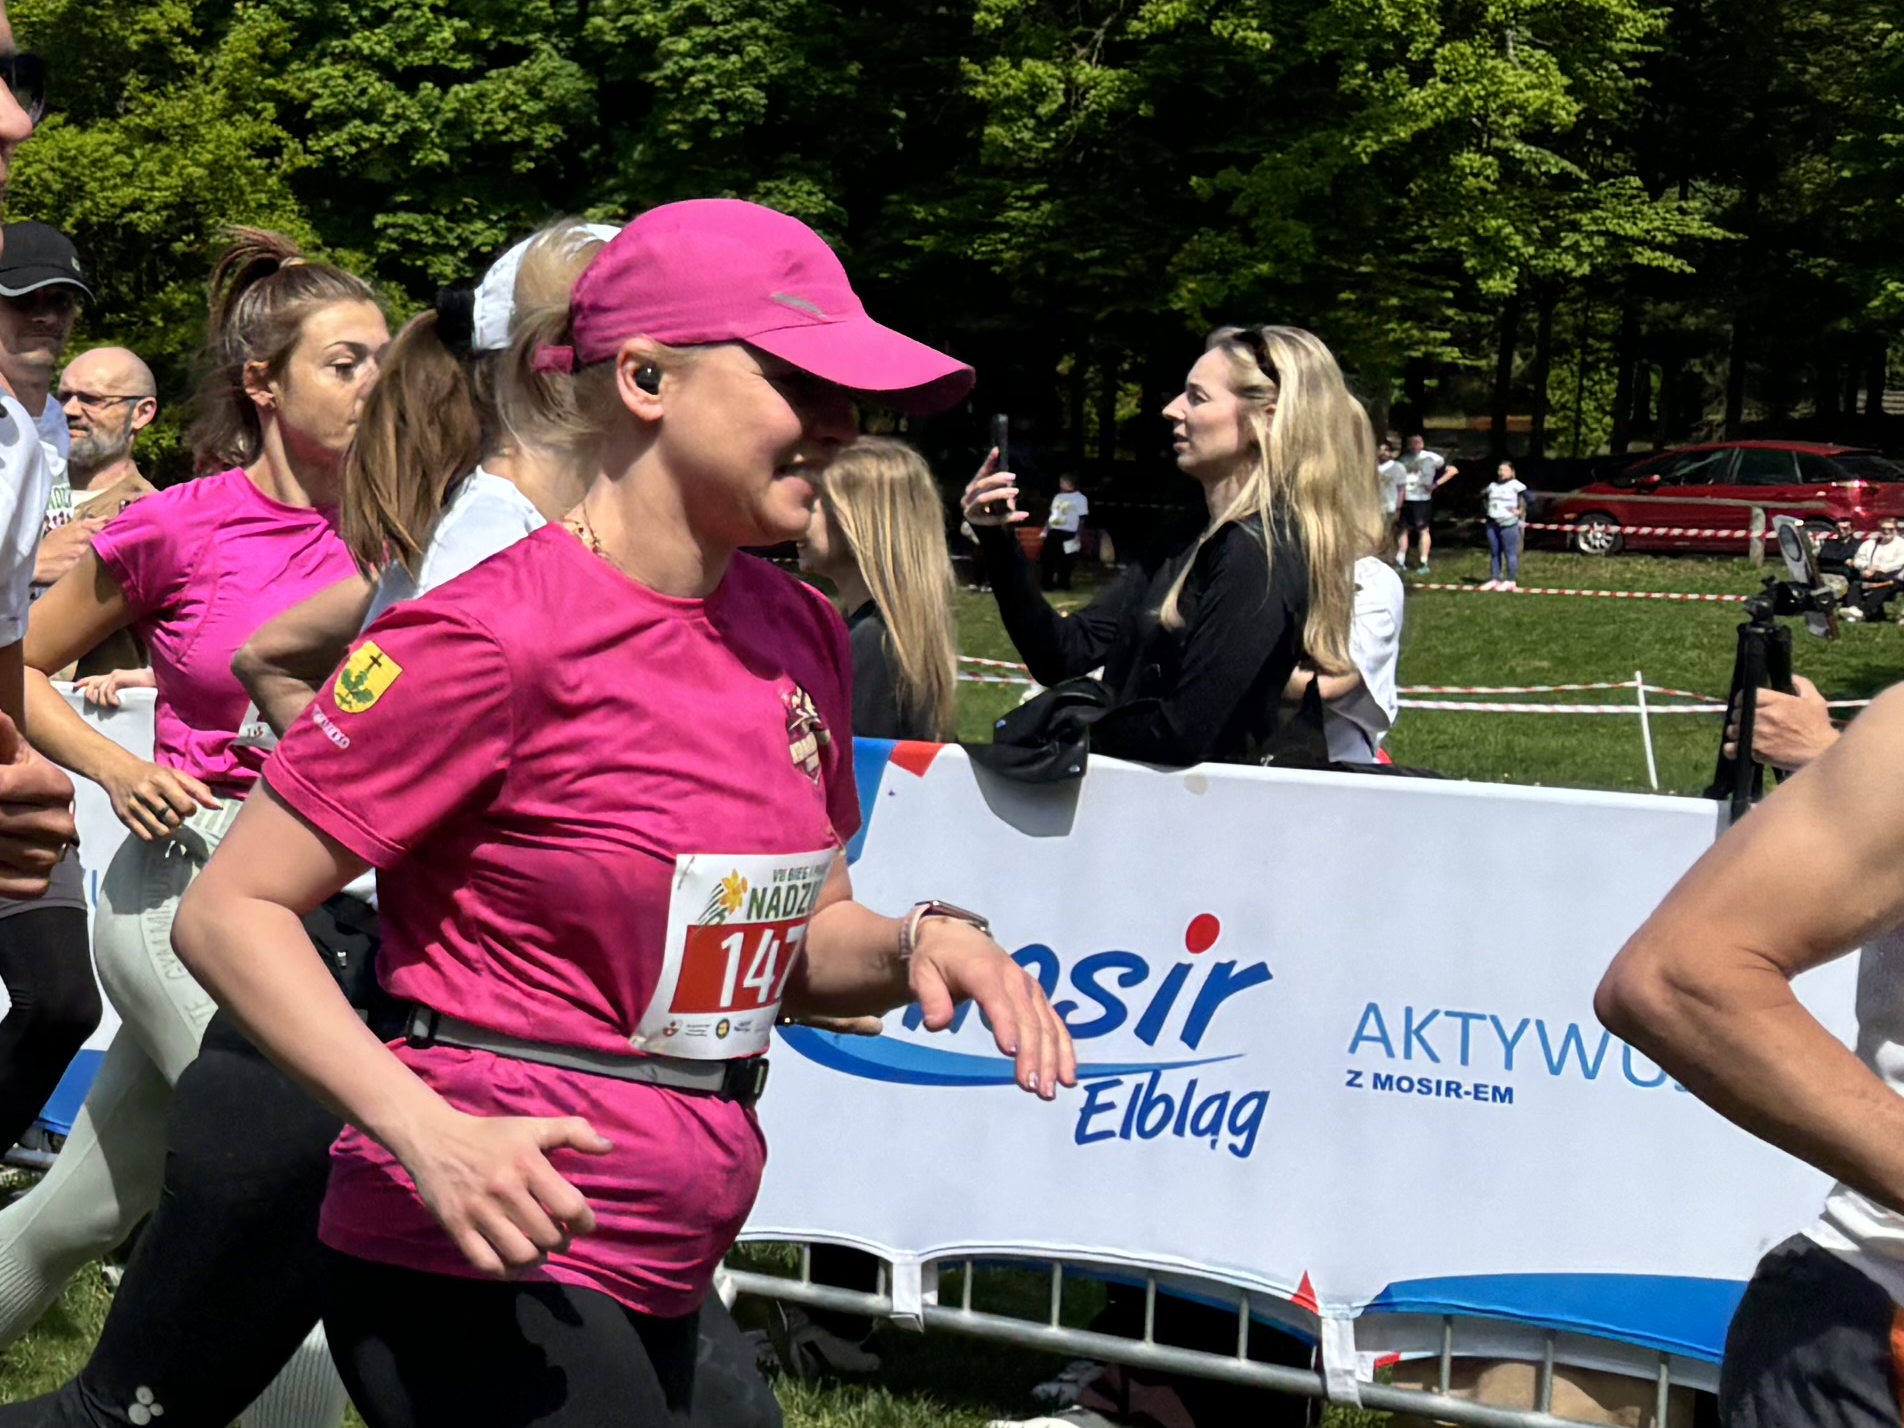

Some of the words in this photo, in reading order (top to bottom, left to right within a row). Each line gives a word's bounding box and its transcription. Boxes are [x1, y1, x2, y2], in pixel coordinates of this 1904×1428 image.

[721, 923, 806, 1008] 147
[1345, 1069, 1364, 1089] Z
[1372, 1072, 1514, 1105] MOSIR-EM
[1348, 1002, 1690, 1093] AKTYWU
[1074, 1067, 1271, 1159] Elbląg
